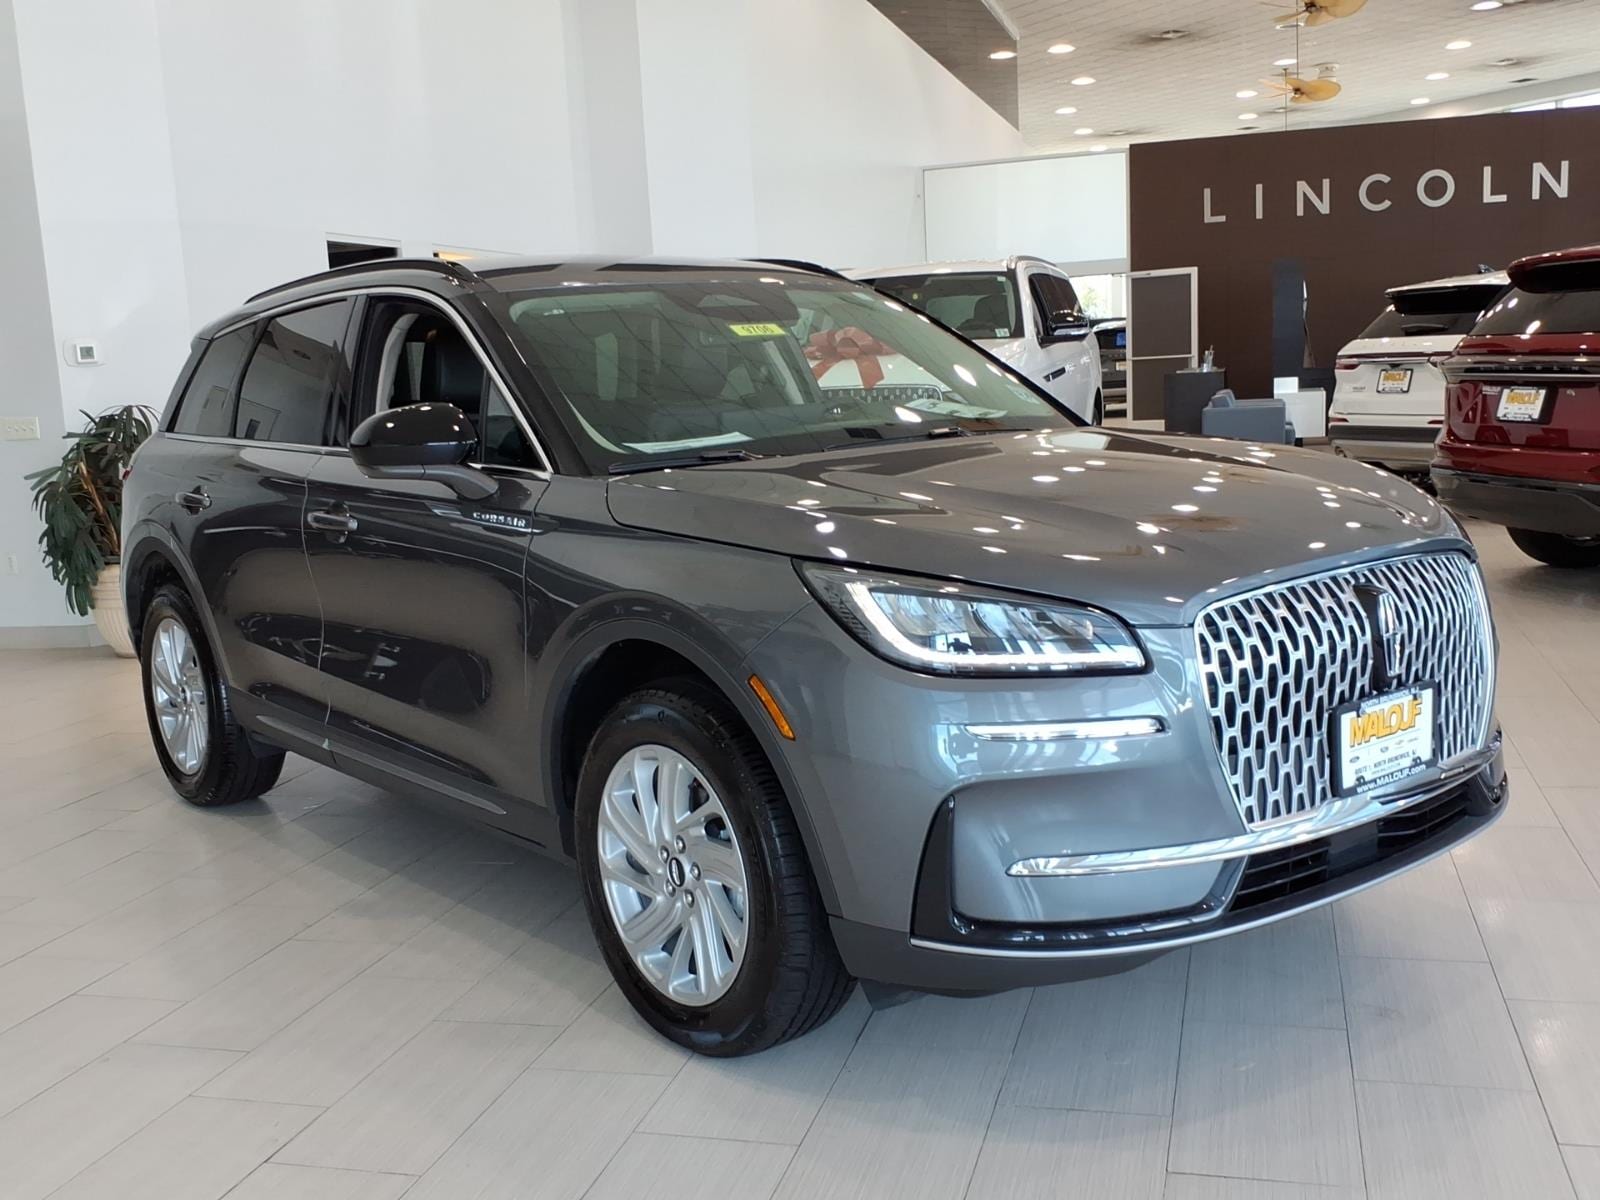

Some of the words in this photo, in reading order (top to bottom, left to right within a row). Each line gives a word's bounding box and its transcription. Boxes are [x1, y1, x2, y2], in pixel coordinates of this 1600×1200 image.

[1203, 160, 1570, 224] LINCOLN
[473, 512, 526, 527] CORSAIR
[1349, 698, 1422, 748] MALOUF
[1356, 764, 1427, 793] www.MALOUF.com
